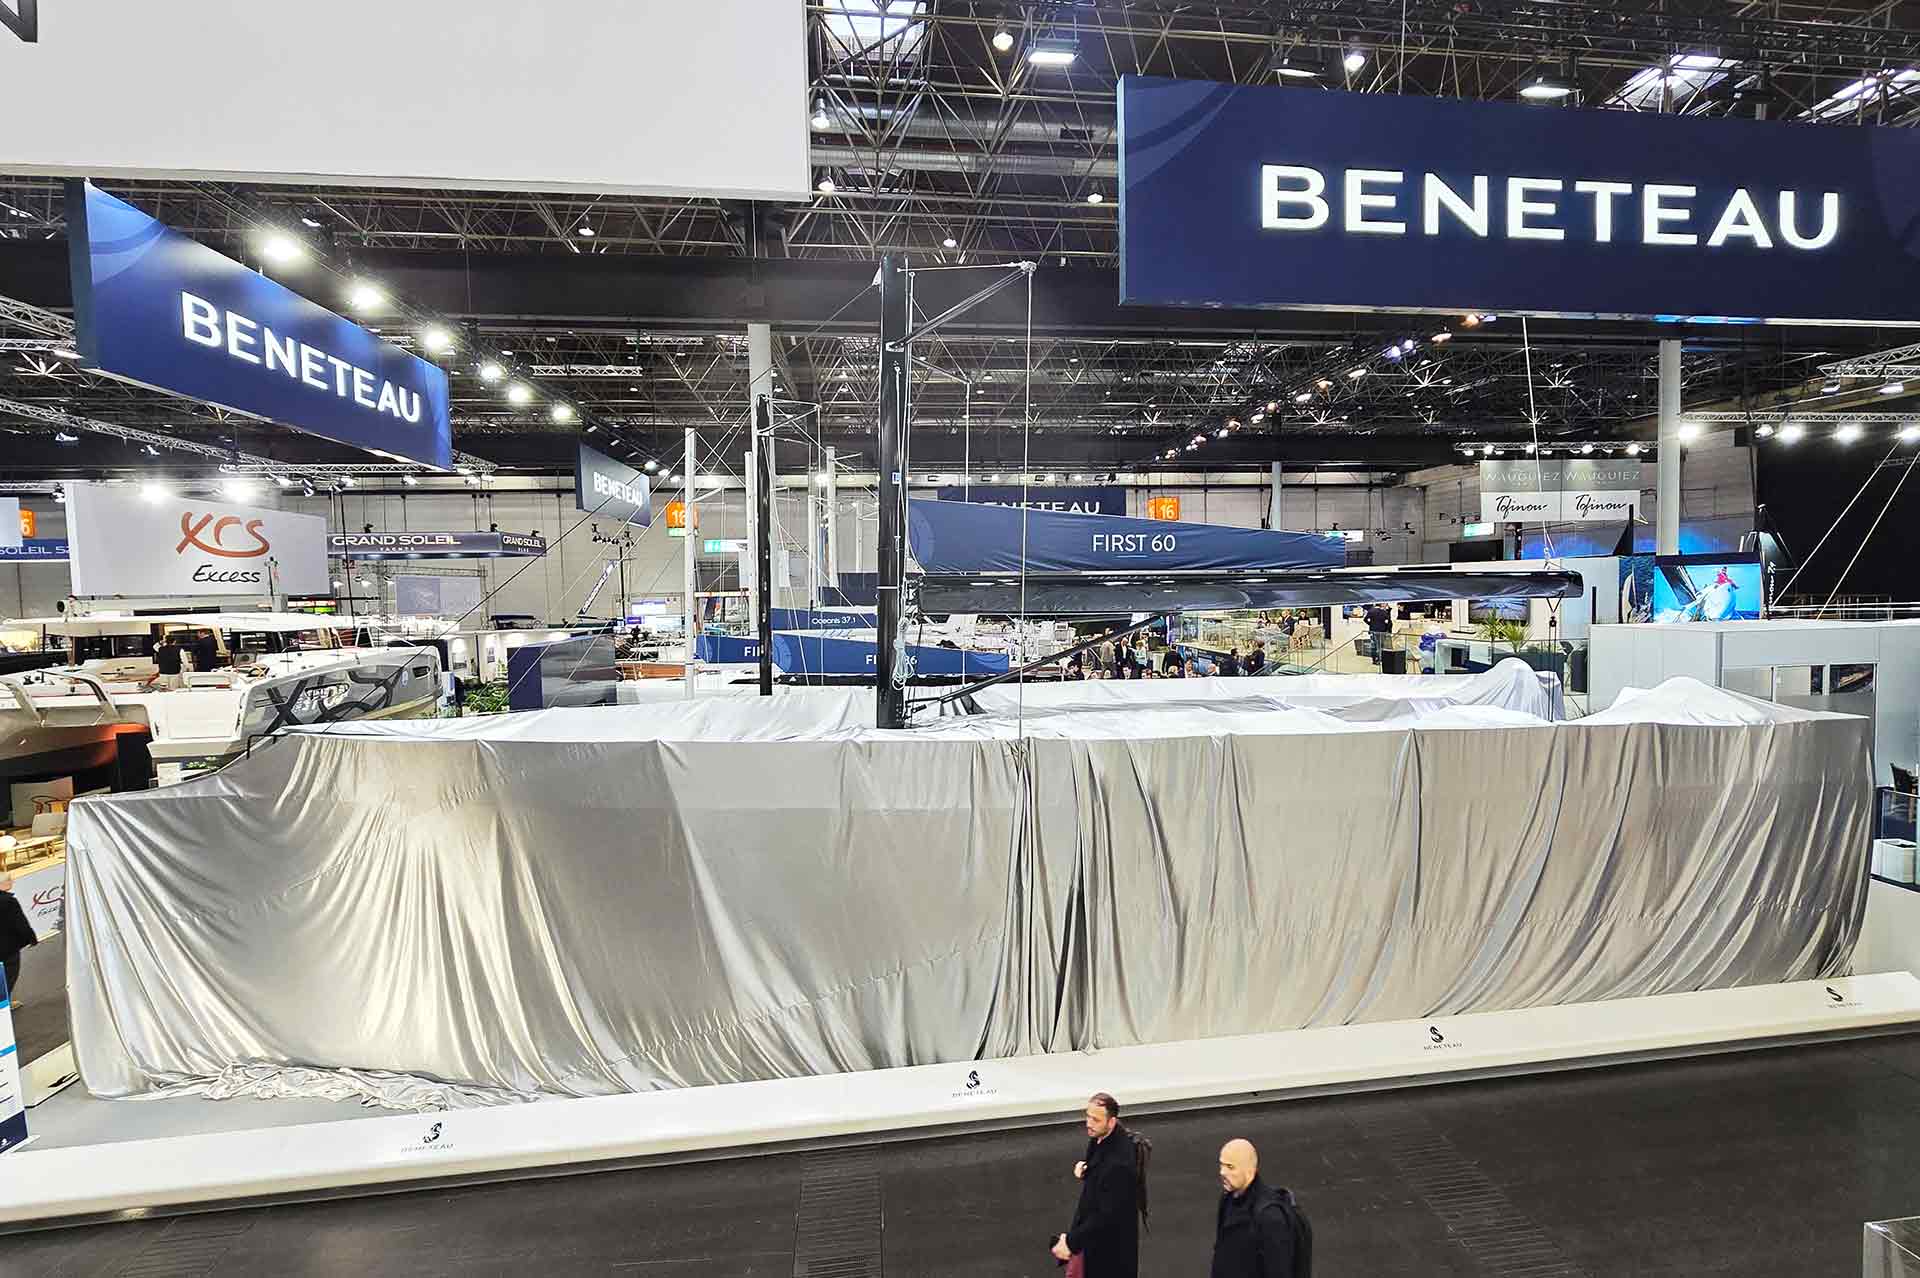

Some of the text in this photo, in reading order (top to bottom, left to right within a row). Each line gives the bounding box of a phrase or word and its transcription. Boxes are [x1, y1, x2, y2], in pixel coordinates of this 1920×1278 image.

[1260, 164, 1840, 250] BENETEAU
[180, 290, 421, 423] BENETEAU
[593, 471, 643, 507] BENETEAU
[1160, 505, 1175, 519] 16
[1495, 495, 1548, 519] Tofinou
[1575, 493, 1627, 518] Tofinou
[332, 535, 462, 546] GRAND SOLEIL
[502, 535, 524, 546] GRAND
[1092, 534, 1176, 552] FIRST 60
[192, 564, 261, 583] Excess
